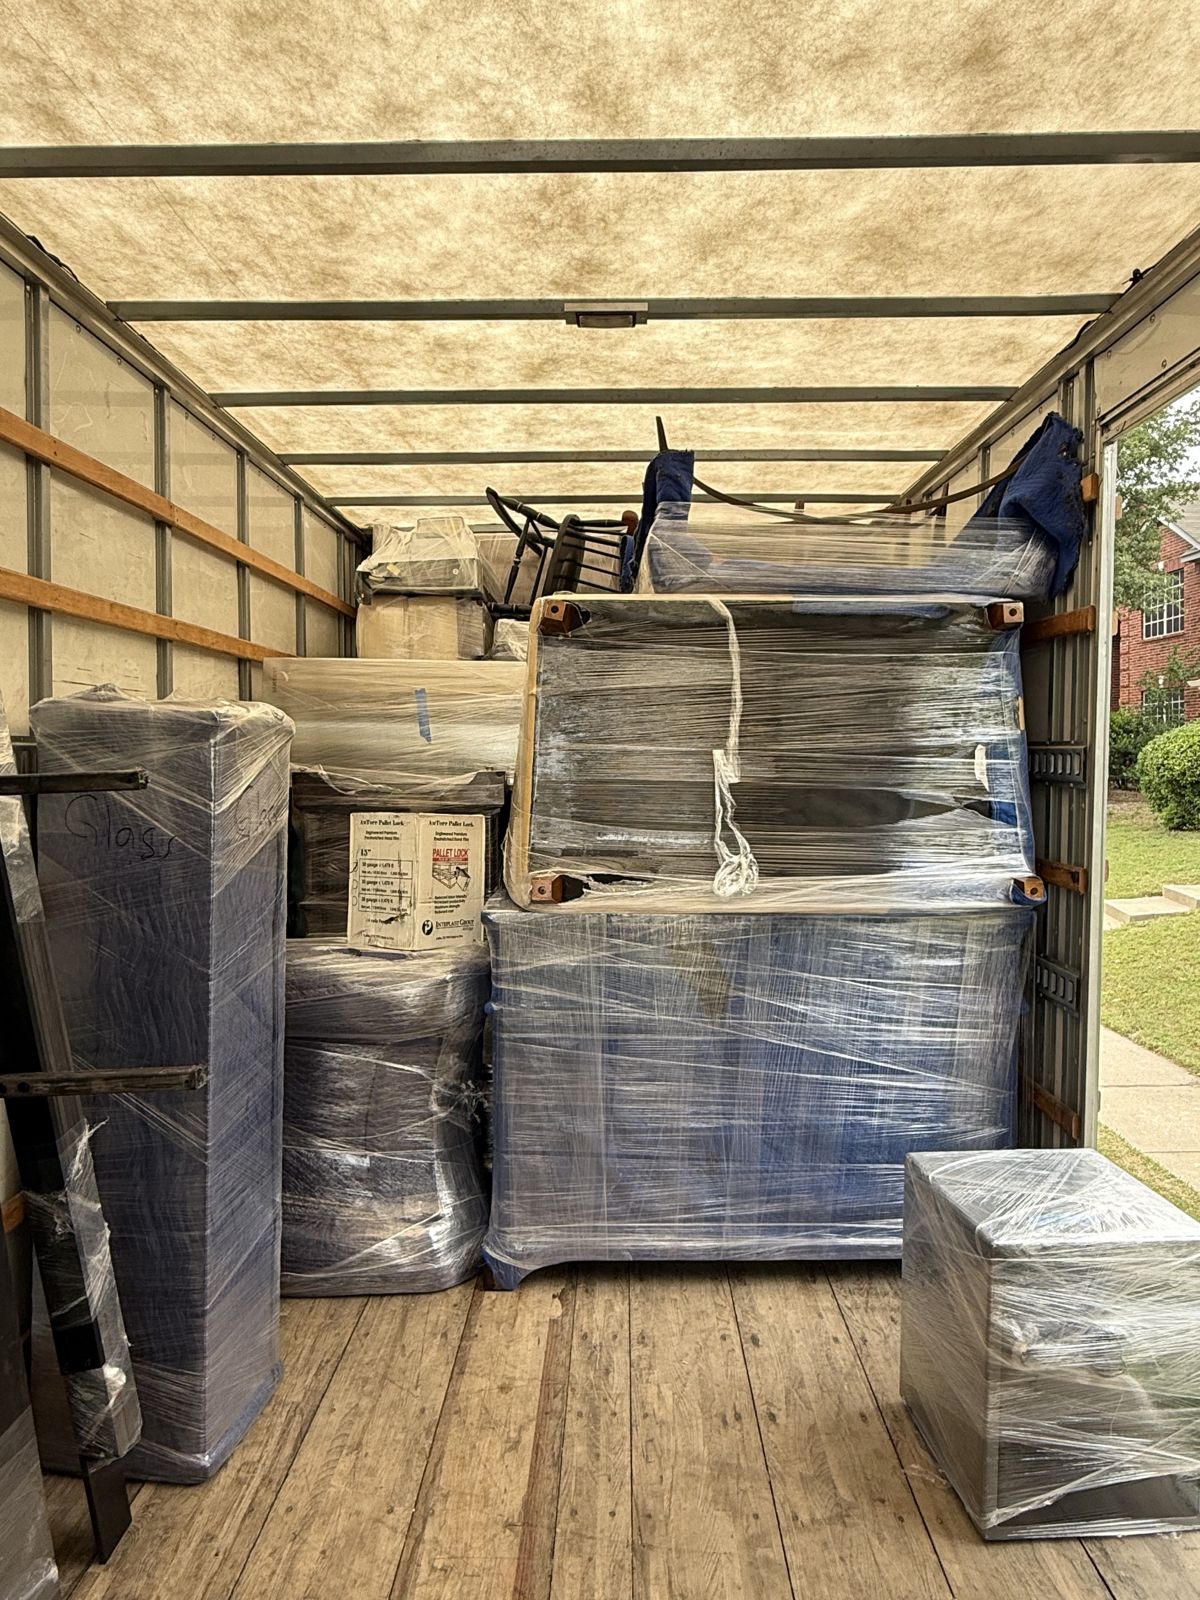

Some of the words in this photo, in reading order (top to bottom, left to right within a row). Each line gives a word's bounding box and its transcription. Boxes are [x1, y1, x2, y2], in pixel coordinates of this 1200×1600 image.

[65, 794, 176, 860] Glass
[432, 848, 453, 858] PALLET
[454, 848, 468, 858] LOCK
